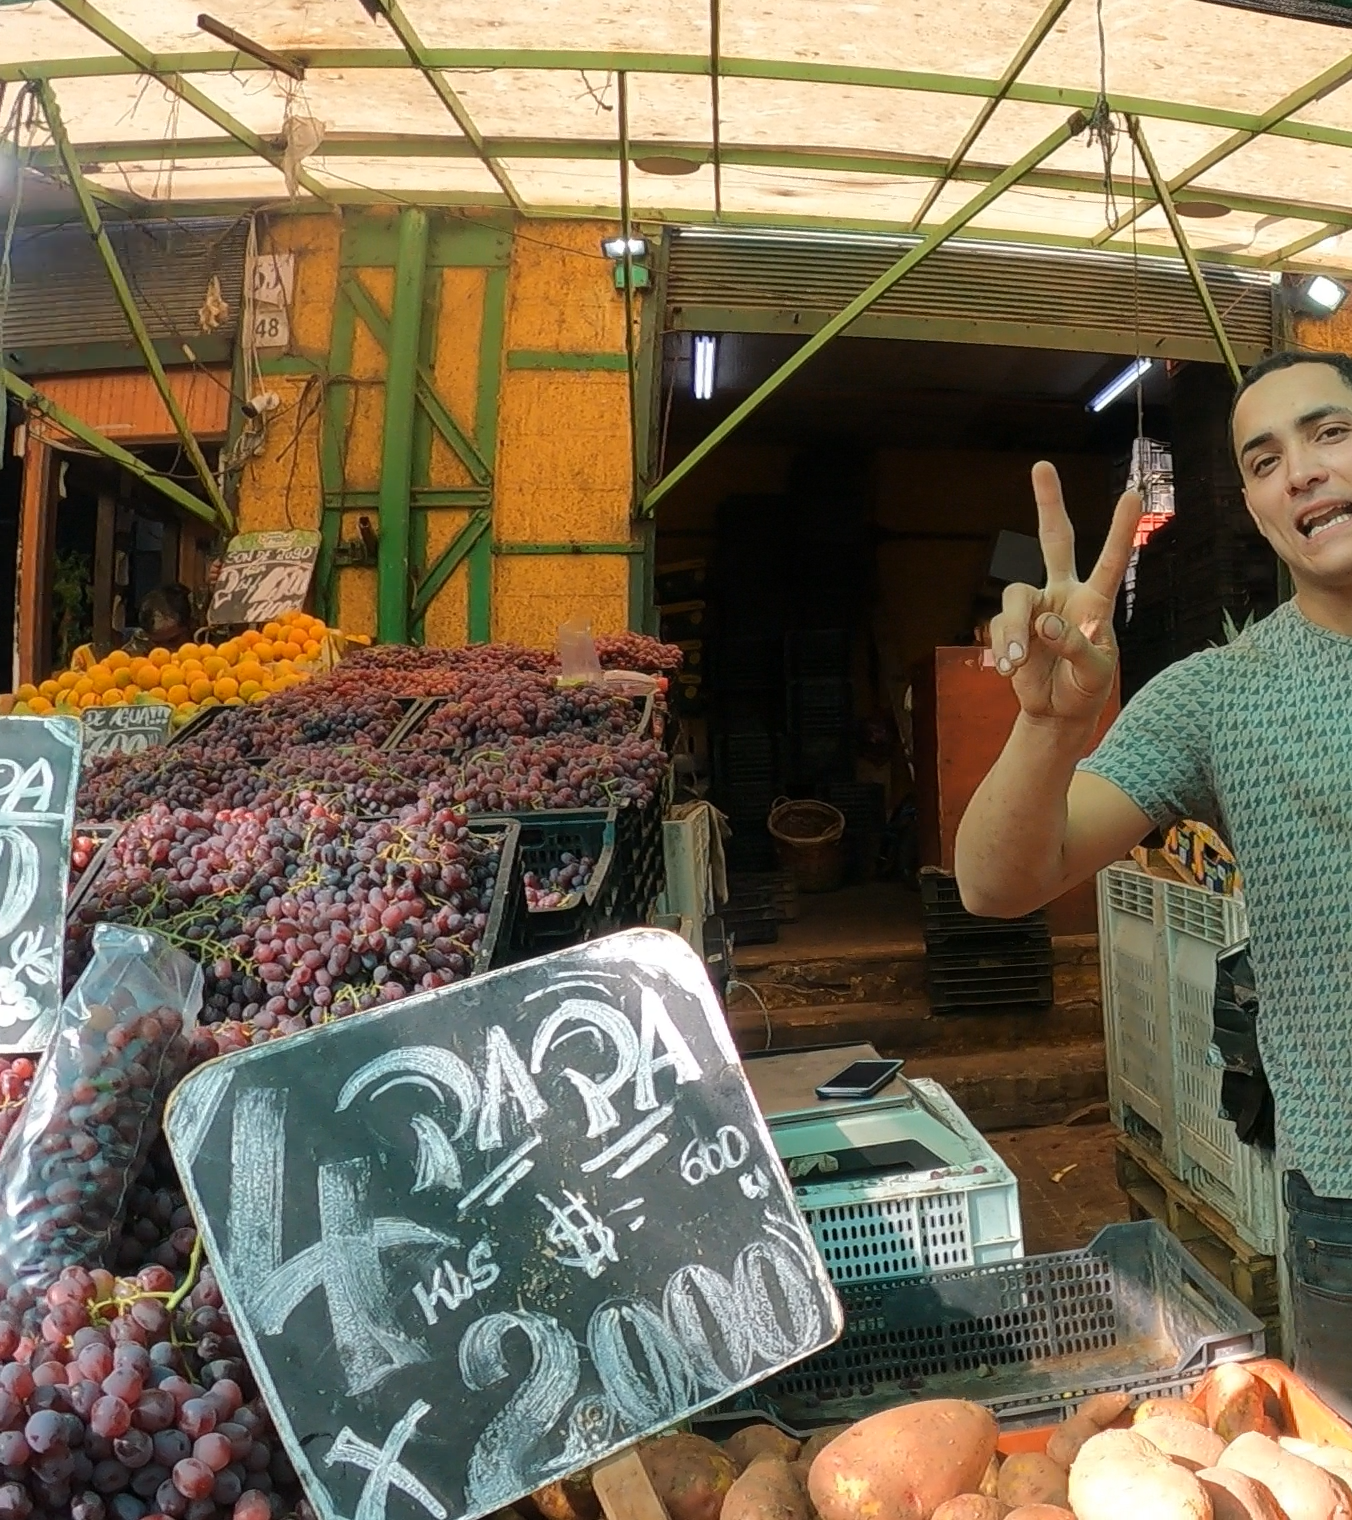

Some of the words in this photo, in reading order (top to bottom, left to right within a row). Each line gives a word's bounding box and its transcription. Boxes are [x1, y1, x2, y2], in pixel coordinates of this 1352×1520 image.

[255, 318, 279, 338] 48
[333, 974, 704, 1194] PAPA
[680, 1125, 750, 1186] 600
